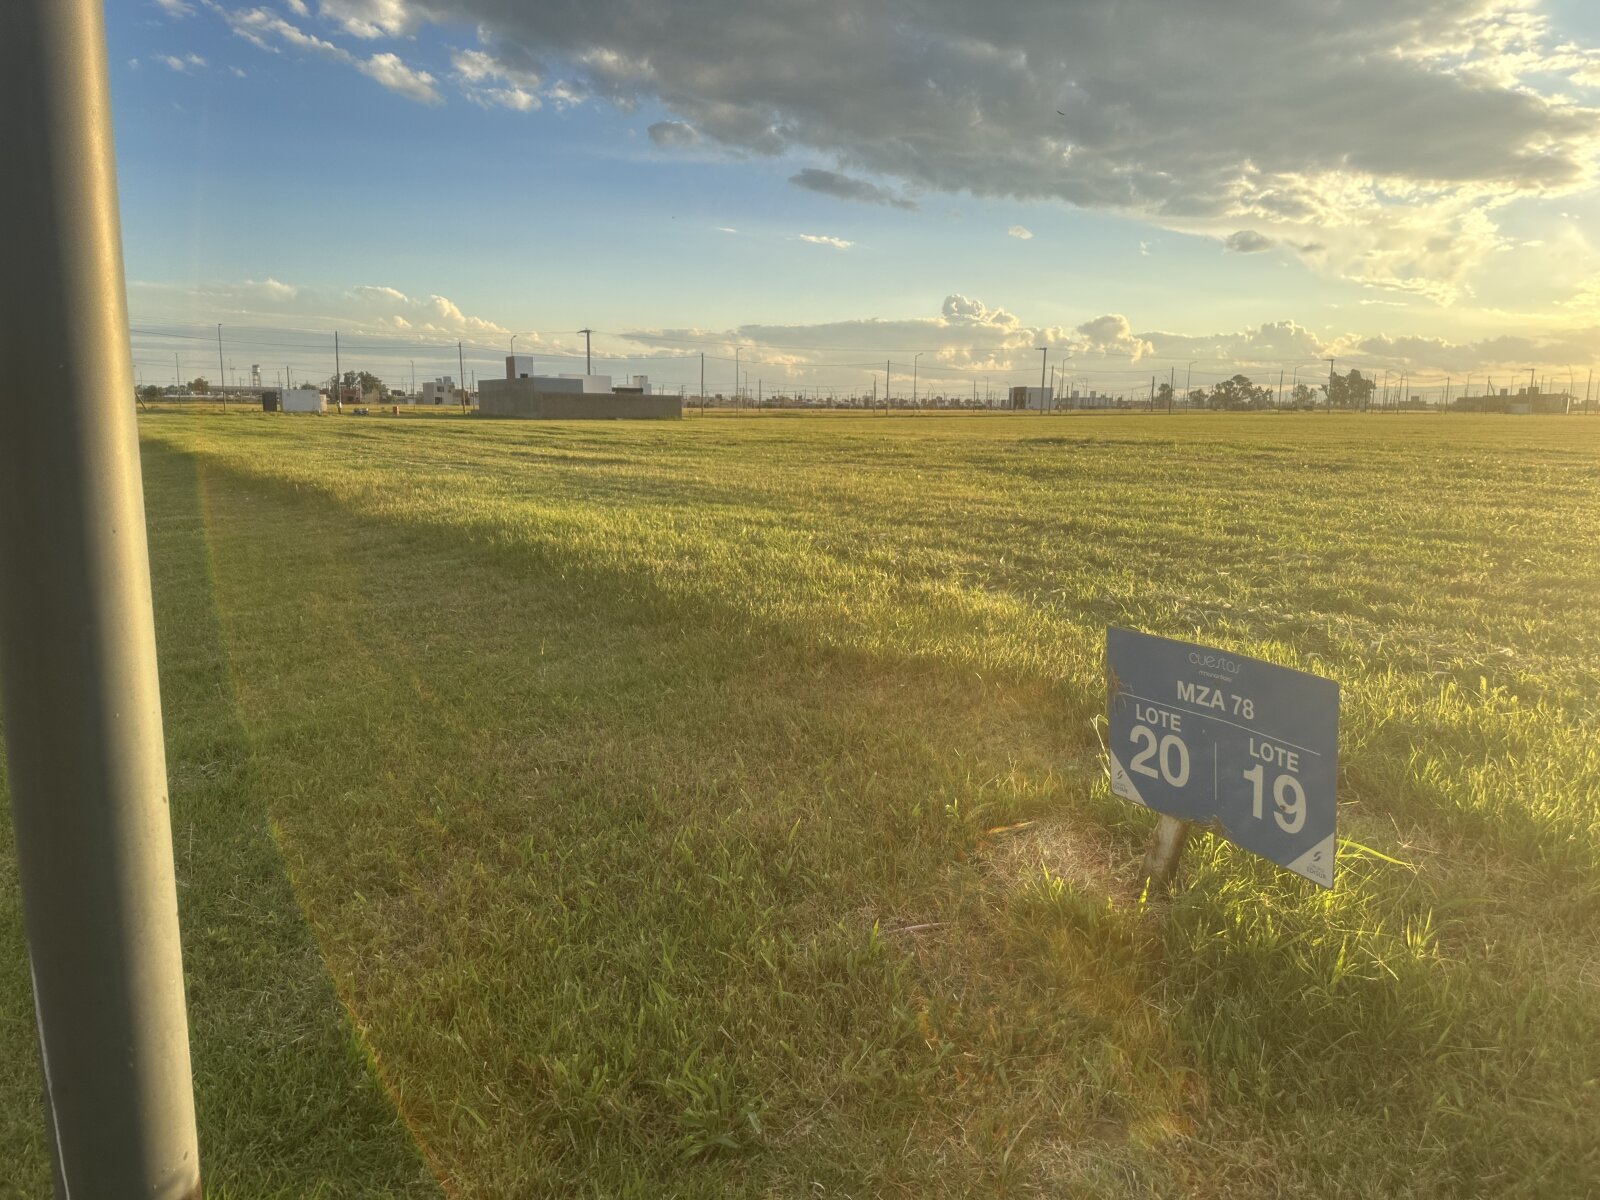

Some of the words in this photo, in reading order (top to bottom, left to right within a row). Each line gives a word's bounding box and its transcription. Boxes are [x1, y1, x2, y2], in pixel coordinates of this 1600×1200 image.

[1135, 704, 1182, 732] LOTE
[1177, 680, 1226, 712] MZA
[1230, 694, 1255, 720] 78
[1129, 724, 1190, 788] 20
[1249, 738, 1299, 773] LOTE
[1243, 764, 1307, 834] 19
